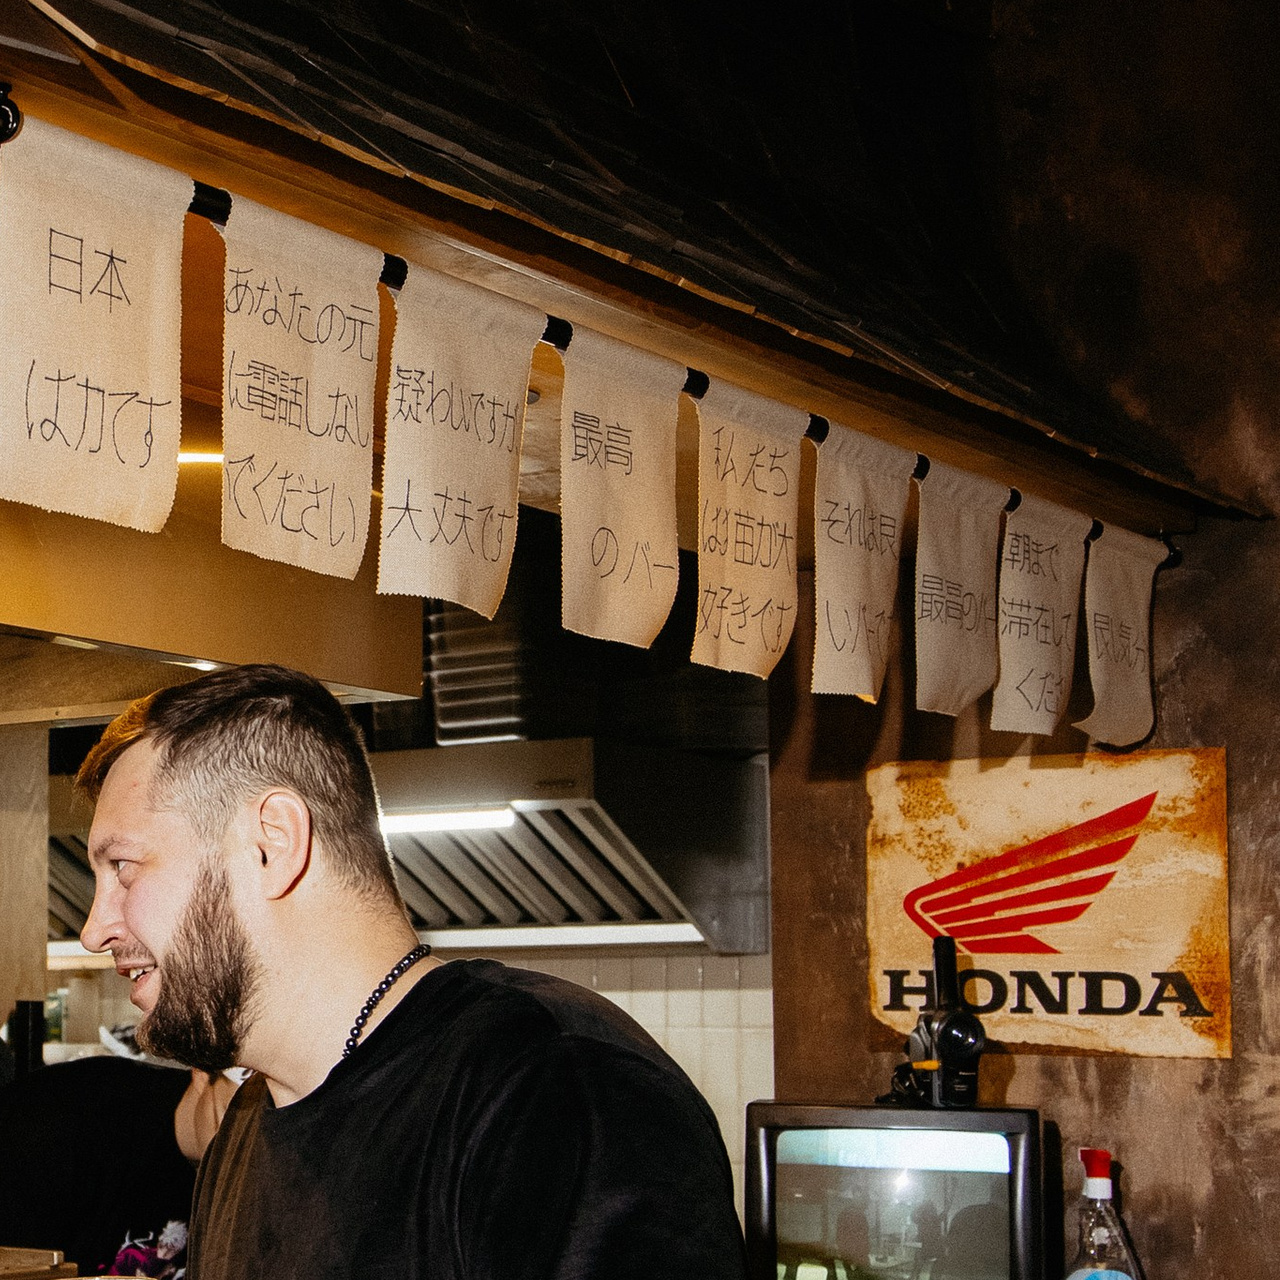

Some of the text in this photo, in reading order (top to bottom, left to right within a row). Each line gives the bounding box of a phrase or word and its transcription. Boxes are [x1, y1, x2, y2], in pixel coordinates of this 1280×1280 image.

[48, 227, 132, 314] 日本
[226, 266, 375, 362] あなたの元
[570, 410, 634, 476] 最高
[712, 425, 790, 497] 私たち
[225, 453, 358, 547] でください
[386, 478, 514, 563] 大丈夫です
[590, 526, 676, 590] のバー
[1004, 531, 1059, 583] 朝まで
[883, 968, 1214, 1018] HONDA
